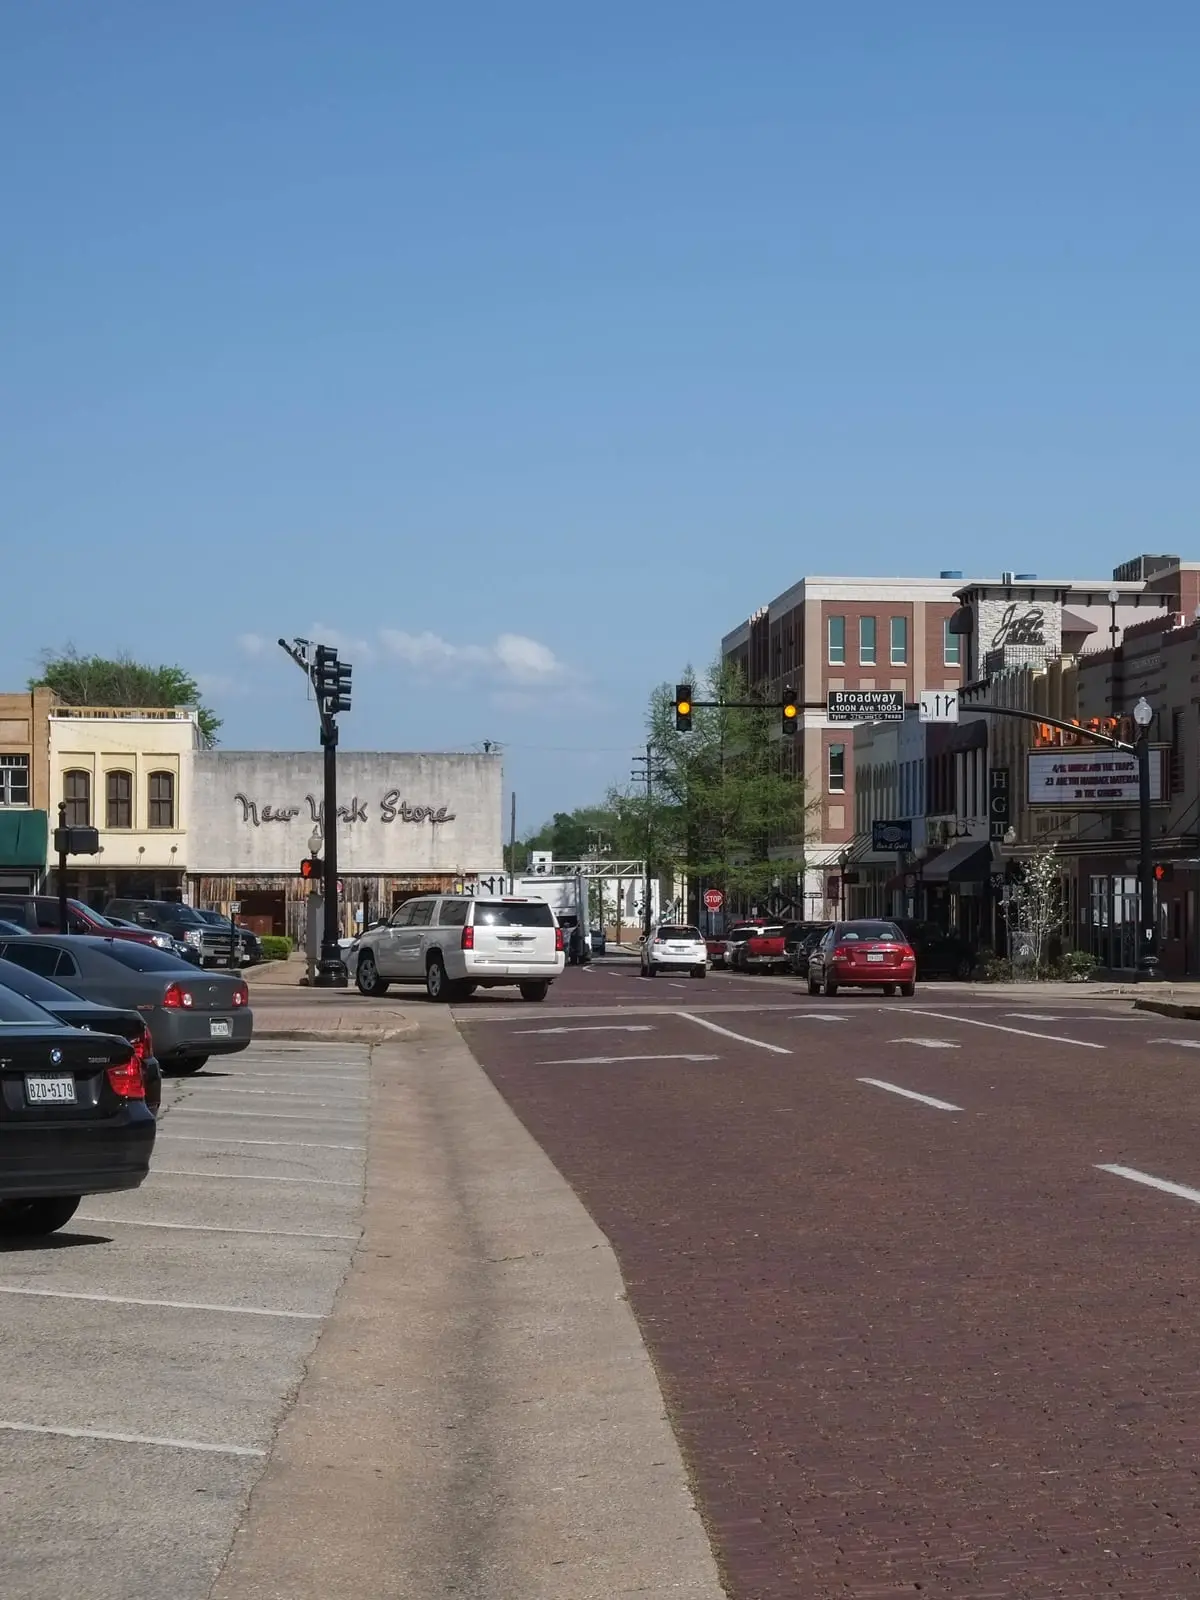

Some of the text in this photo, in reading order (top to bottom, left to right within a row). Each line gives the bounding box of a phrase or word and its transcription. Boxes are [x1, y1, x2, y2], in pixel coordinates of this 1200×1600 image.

[836, 692, 896, 705] Broadway
[832, 713, 847, 721] Tyler
[234, 789, 457, 836] New Yrk Store
[705, 895, 722, 903] STOP
